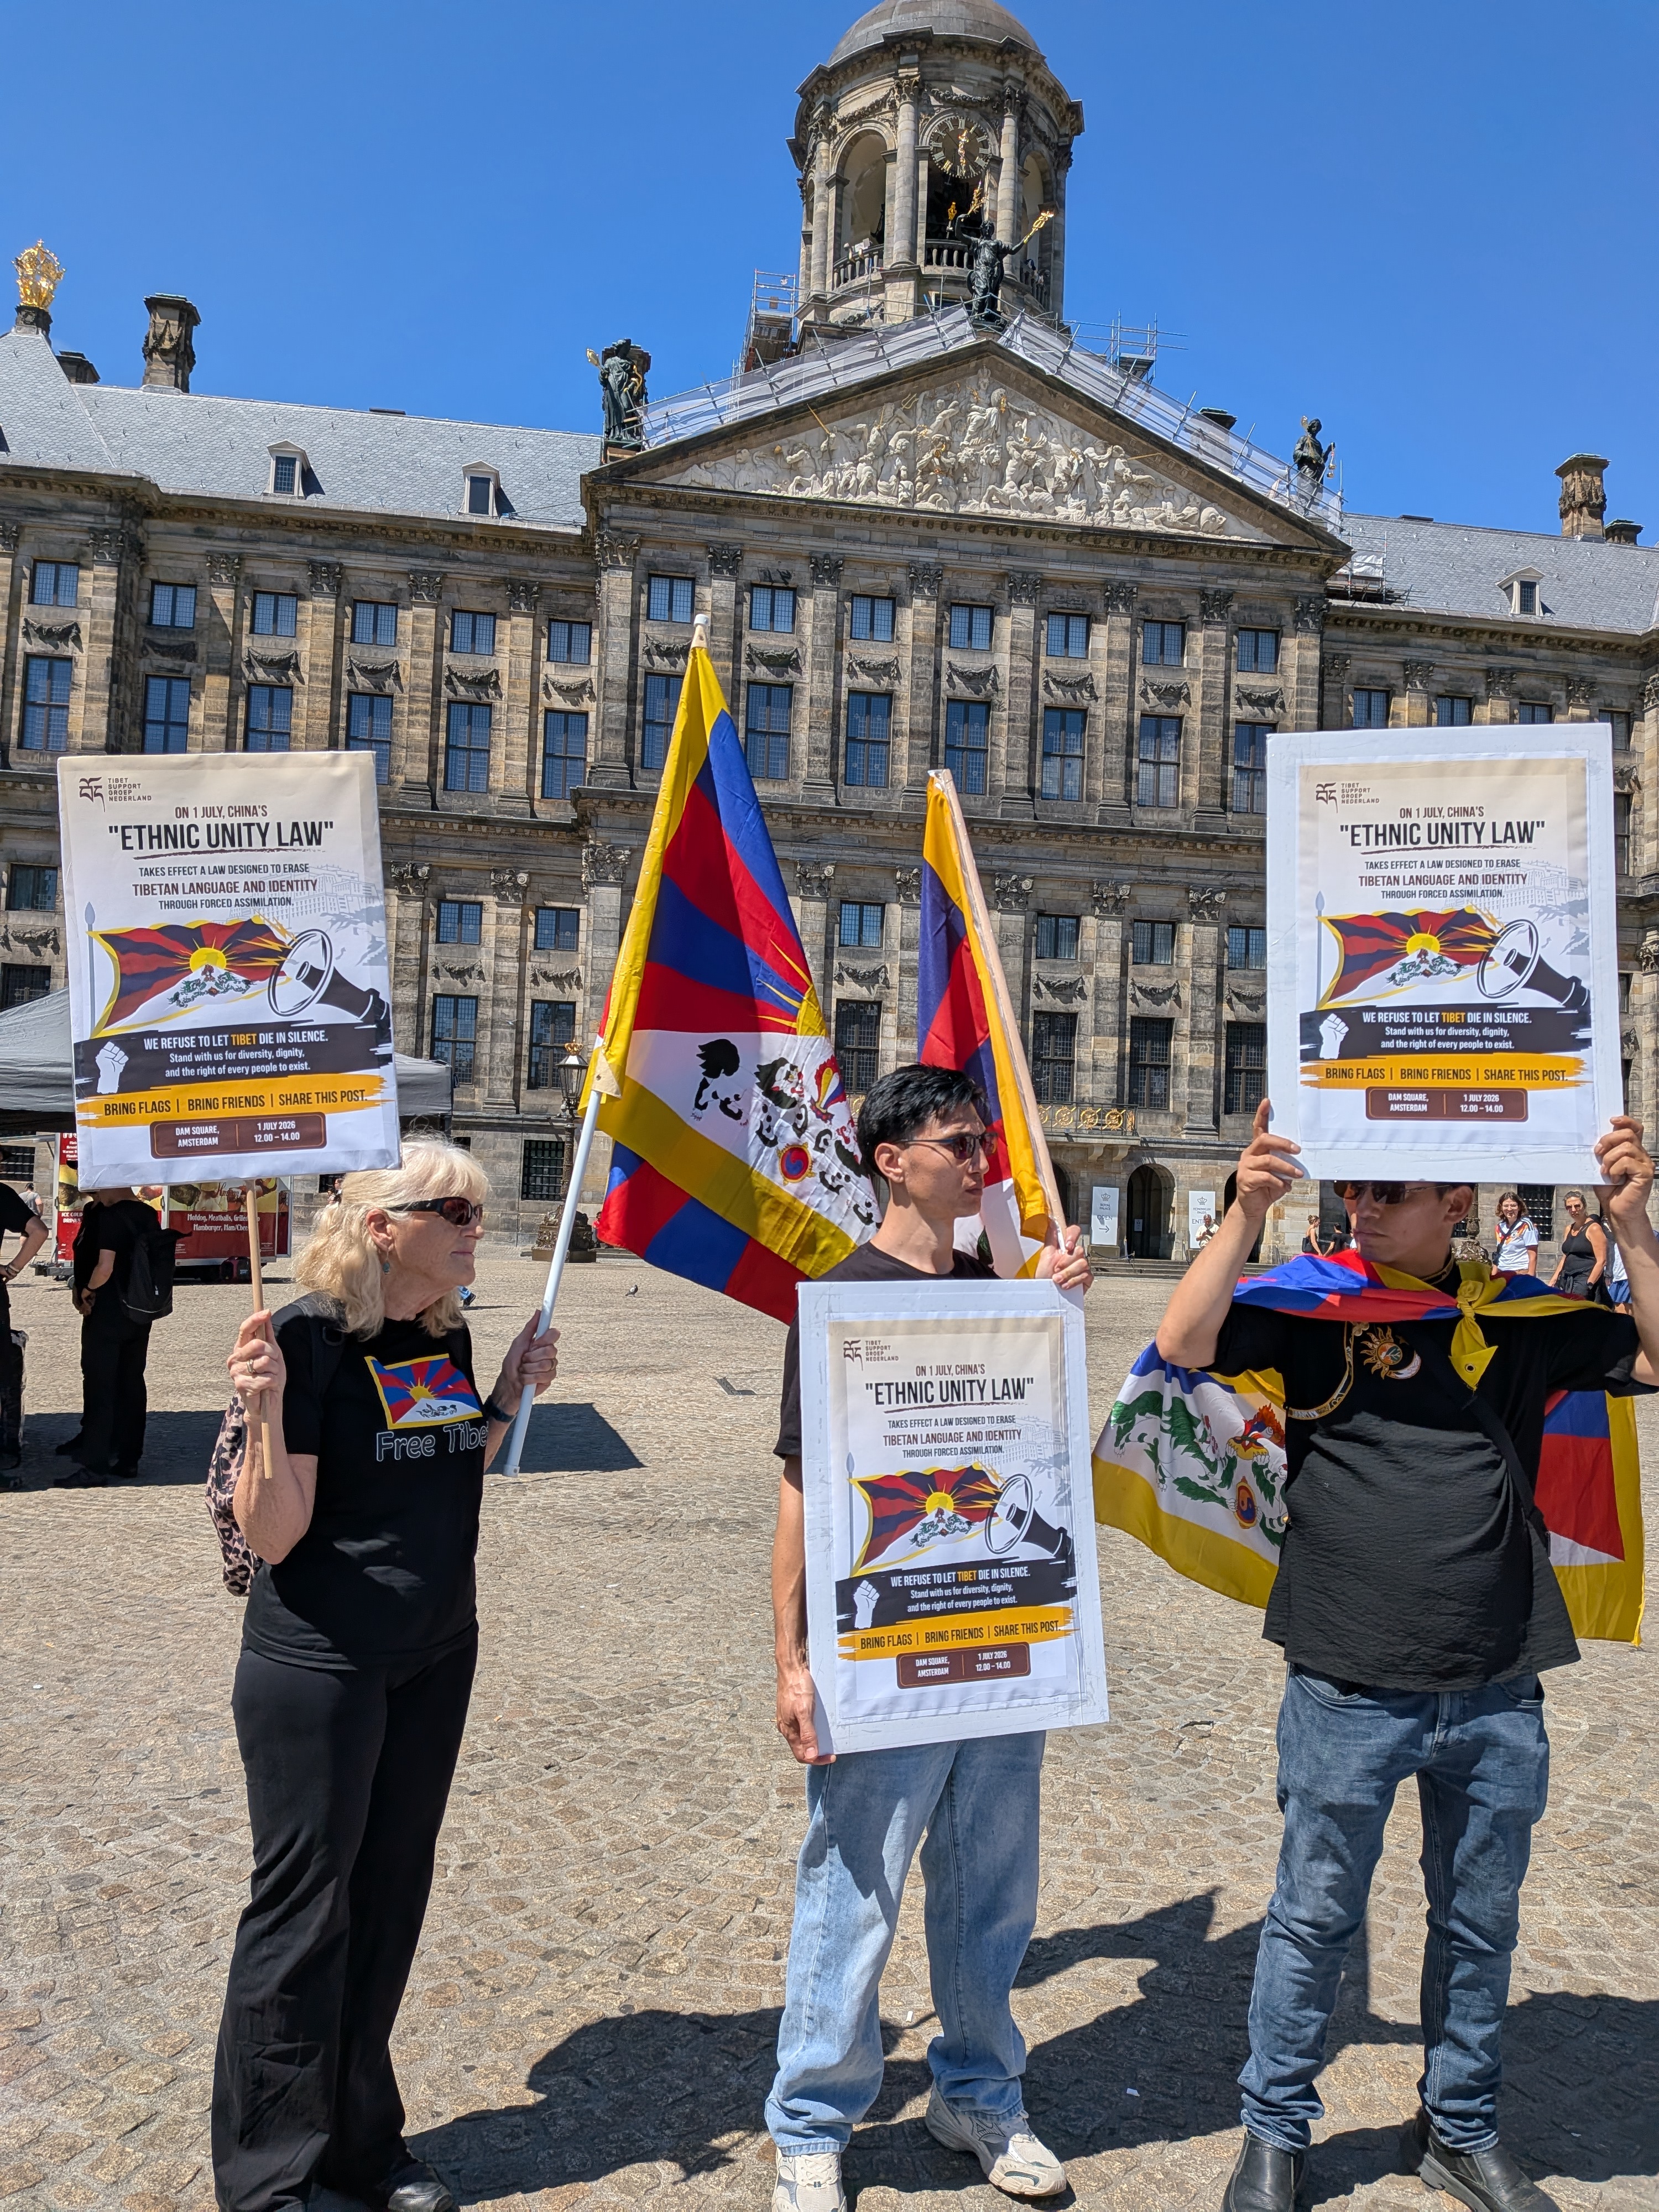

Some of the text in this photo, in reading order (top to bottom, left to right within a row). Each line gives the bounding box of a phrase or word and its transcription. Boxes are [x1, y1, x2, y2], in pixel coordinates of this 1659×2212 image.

[175, 805, 268, 820] ON 1 JULY, CHINA'S
[1399, 806, 1484, 819] ON 1 JULY, CHINA'S
[108, 821, 333, 851] "ETHNIC UNITY LAW"
[1340, 821, 1545, 847] "ETHNIC UNITY LAW"
[138, 863, 310, 877] TAKES EFFECT A LAW DESIGNED TO ERASE
[1358, 873, 1527, 886] TIBETAN LANGUAGE AND IDENTITY
[132, 878, 317, 896] TIBETAN LANGUAGE AND IDENTITY
[1381, 889, 1505, 899] THROUGH FORCED ASSIMILATION.
[158, 896, 294, 910] THROUGH FORCED ASSIMILATION.
[1362, 1011, 1532, 1024] WE REFUSE TO LET TIBET DIE IN SILENCE.
[1385, 1026, 1406, 1036] Stand
[1407, 1026, 1424, 1036] with
[1434, 1026, 1447, 1036] for
[1447, 1026, 1481, 1037] diversity,
[1482, 1026, 1510, 1038] dignity,
[143, 1030, 328, 1050] WE REFUSE TO LET TIBET DIE IN SILENCE.
[169, 1047, 305, 1063] Stand with us for diversity, dignity,
[165, 1061, 311, 1077] and the right of every people to exist.
[1326, 1067, 1568, 1081] BRING FLAGS BRING FRIENDS SHARE THIS POST.
[104, 1089, 368, 1116] BRING FLAGS BRING FRIENDS SHARE THIS POST.
[175, 1125, 220, 1136] DAM SQUARE,
[257, 1120, 296, 1131] 1 JULY 2026
[178, 1136, 218, 1147] AMSTERDAM
[254, 1133, 273, 1142] 12.00
[280, 1131, 300, 1141] 14.00
[915, 1363, 985, 1376] ON 1 JULY, CHINA'S
[865, 1377, 1034, 1405] "ETHNIC UNITY LAW"
[887, 1415, 1016, 1428] TAKES EFFECT A LAW DESIGNED TO ERASE
[376, 1421, 489, 1462] Free Tibe
[883, 1428, 1022, 1446] TIBETAN LANGUAGE AND IDENTITY
[902, 1444, 1005, 1458] THROUGH FORCED ASSIMILATION.
[890, 1566, 1031, 1587] WE REFUSE TO LET TIBET DIE IN SILENCE.
[860, 1620, 1061, 1650] BRING FLAGS BRING FRIENDS SHARE THIS POST.
